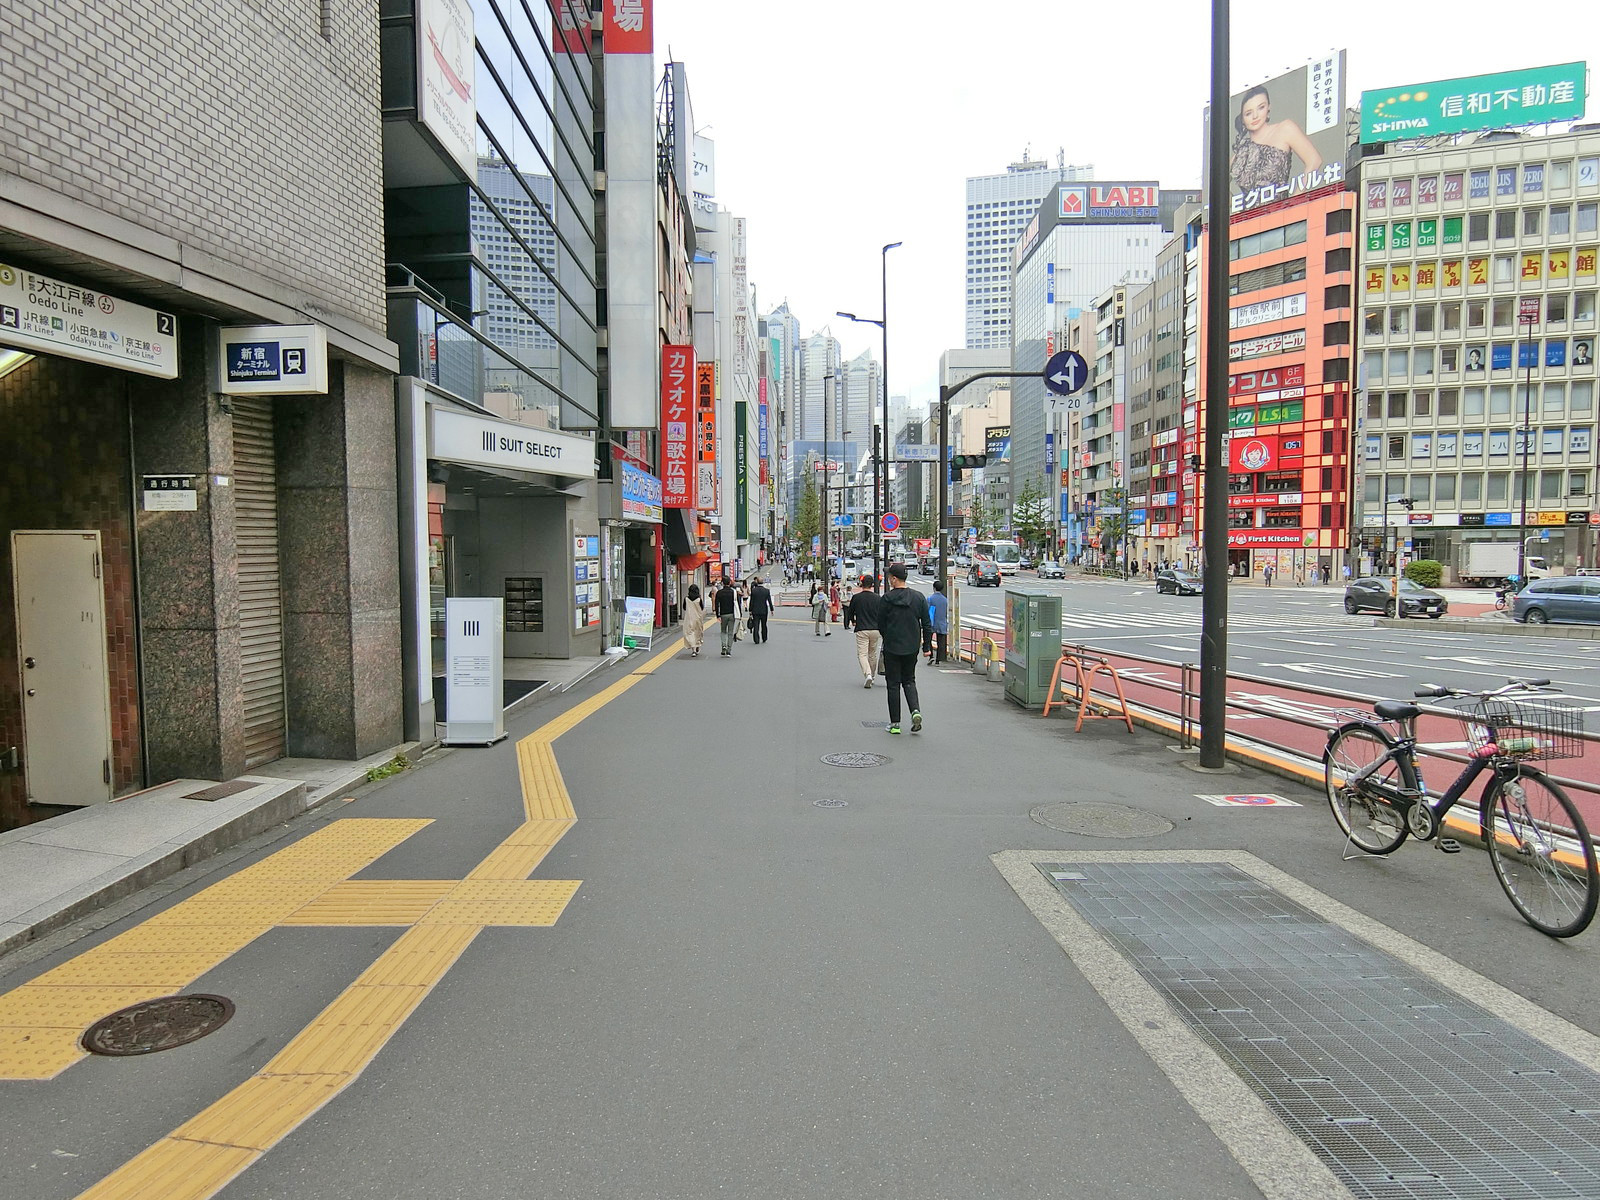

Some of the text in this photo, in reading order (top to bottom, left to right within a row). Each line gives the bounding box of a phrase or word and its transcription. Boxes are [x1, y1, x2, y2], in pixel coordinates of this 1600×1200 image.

[1312, 62, 1322, 112] 面白くする。
[1324, 58, 1333, 124] 世界の不動産を
[1439, 80, 1575, 118] 信和不動産
[1523, 170, 1543, 184] ZERO
[1090, 187, 1158, 207] LABI
[1090, 208, 1133, 217] SHINJUKU
[1369, 222, 1432, 238] ほぐし
[1522, 255, 1595, 277] 占い館
[1367, 269, 1434, 290] 占い館
[37, 279, 96, 308] 大江戸線
[28, 293, 84, 317] Oedo Line
[1239, 300, 1282, 317] 新宿駅前
[23, 311, 50, 327] JR線
[161, 316, 170, 333] 2
[23, 322, 55, 337] JR Lines
[69, 323, 108, 341] 小田急線
[69, 333, 113, 351] Odakyu Line
[125, 337, 151, 352] 京王線
[125, 347, 155, 361] Keio Line
[241, 347, 265, 360] 新宿
[230, 368, 278, 377] Shinjuku Terminal
[236, 361, 271, 369] ターミナル
[1287, 367, 1300, 376] 6F
[668, 351, 686, 420] カラオケ
[700, 371, 711, 408] 大黒屋
[499, 437, 562, 459] SUIT SELECT
[666, 442, 687, 495] 歌広場
[664, 496, 688, 504] 受付7F
